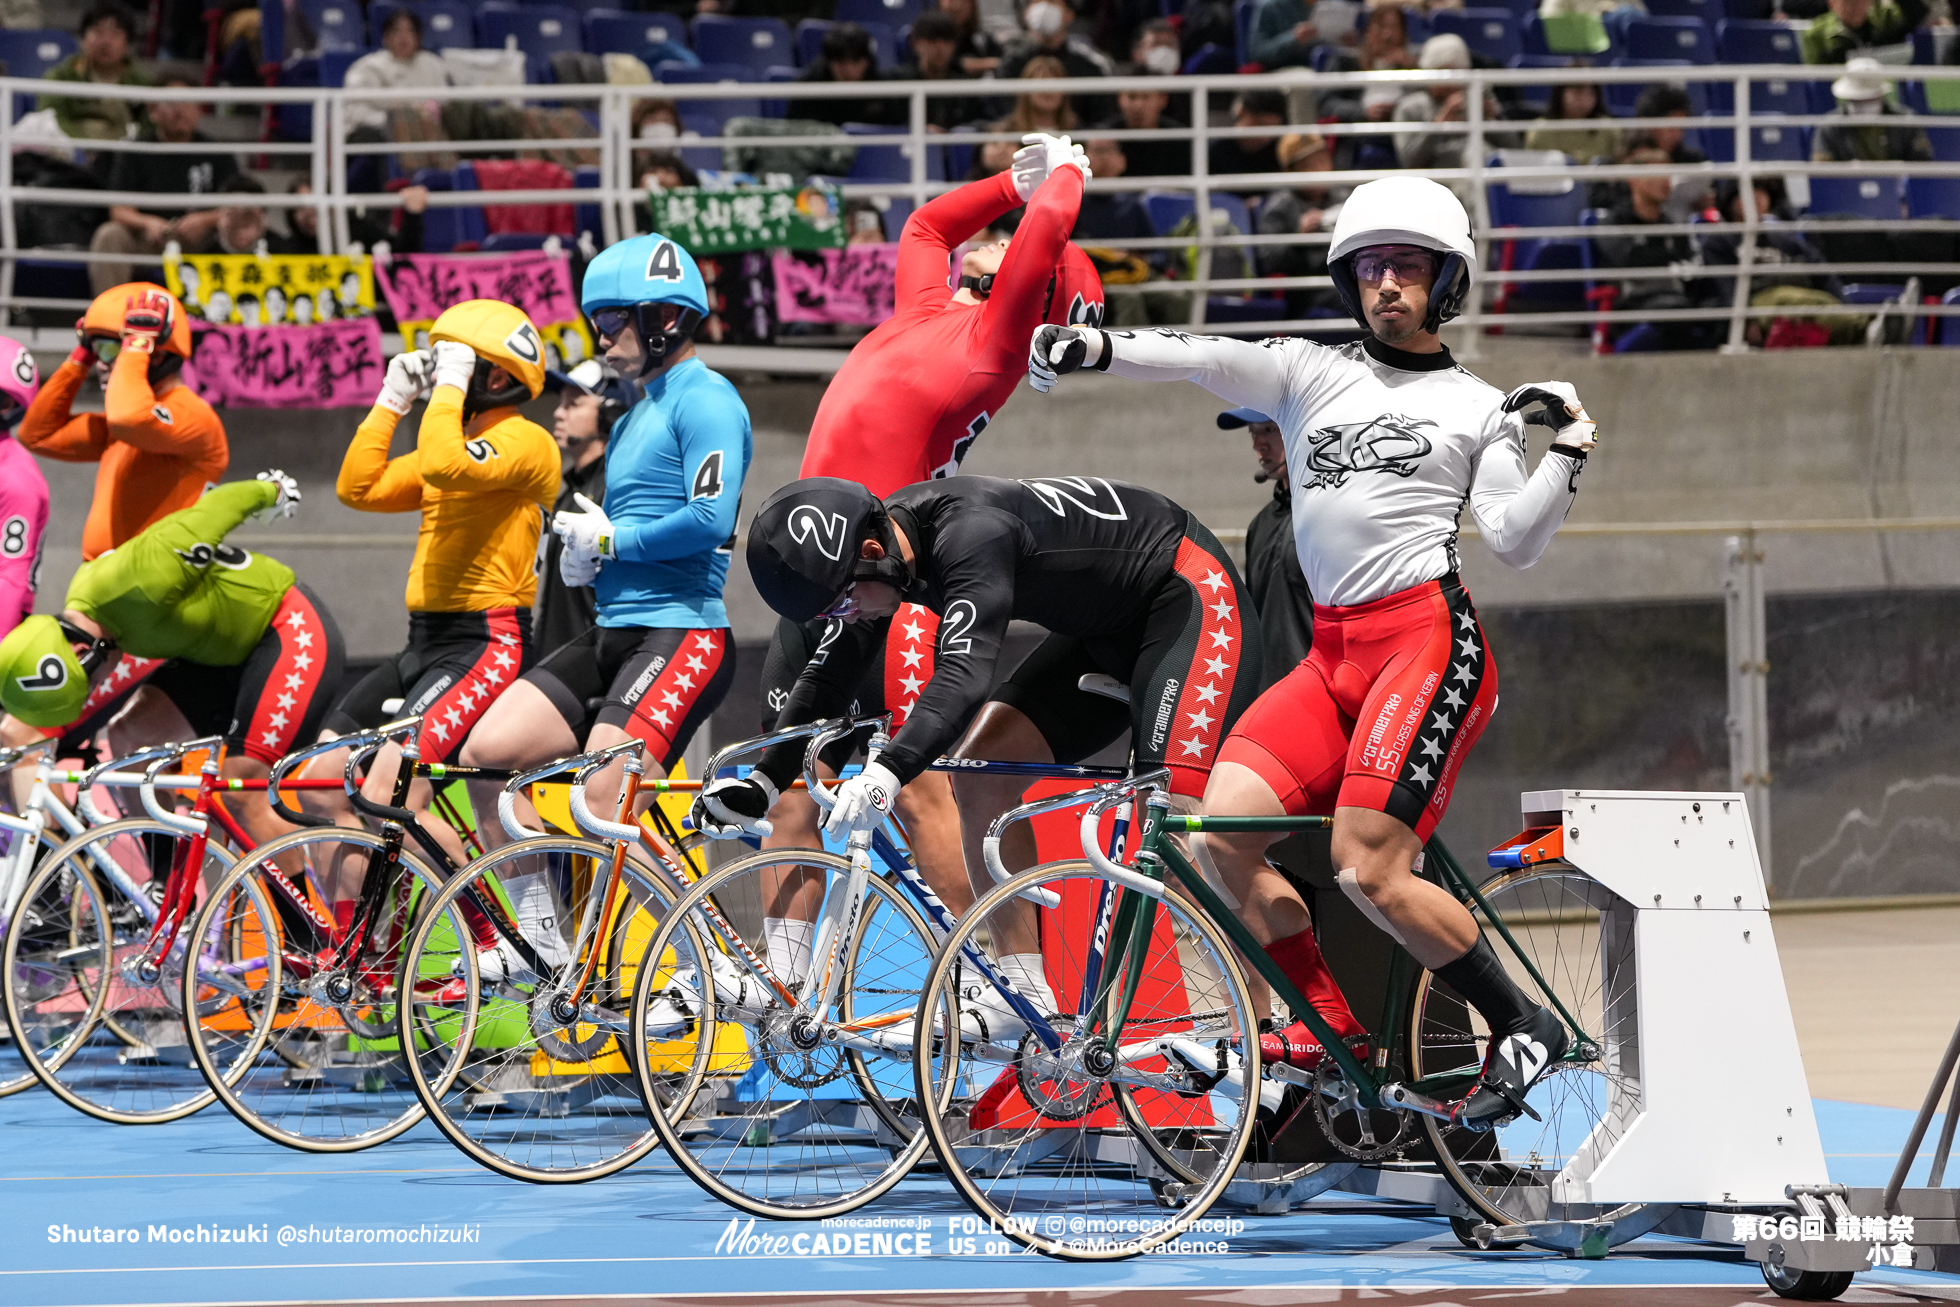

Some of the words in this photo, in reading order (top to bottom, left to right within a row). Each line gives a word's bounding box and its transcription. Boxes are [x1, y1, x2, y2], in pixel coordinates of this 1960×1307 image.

[644, 238, 685, 284] 4
[231, 329, 376, 399] 新山響平
[503, 320, 544, 365] 5
[11, 347, 37, 388] 8
[465, 437, 499, 464] 5
[691, 450, 724, 500] 4
[2, 515, 29, 558] 8
[788, 504, 848, 562] 2
[808, 618, 844, 666] 2
[939, 599, 977, 656] 2
[15, 653, 68, 692] 9
[1419, 670, 1440, 698] KEIRIN
[1404, 705, 1421, 727] KING
[1413, 694, 1427, 709] OF
[1393, 725, 1413, 751] CLASS
[1441, 757, 1454, 783] CLASS
[1451, 737, 1463, 758] KING
[1459, 727, 1469, 740] OF
[1466, 704, 1483, 730] KEIRIN
[932, 757, 989, 769] esto
[658, 853, 780, 986] BRIGESTONE
